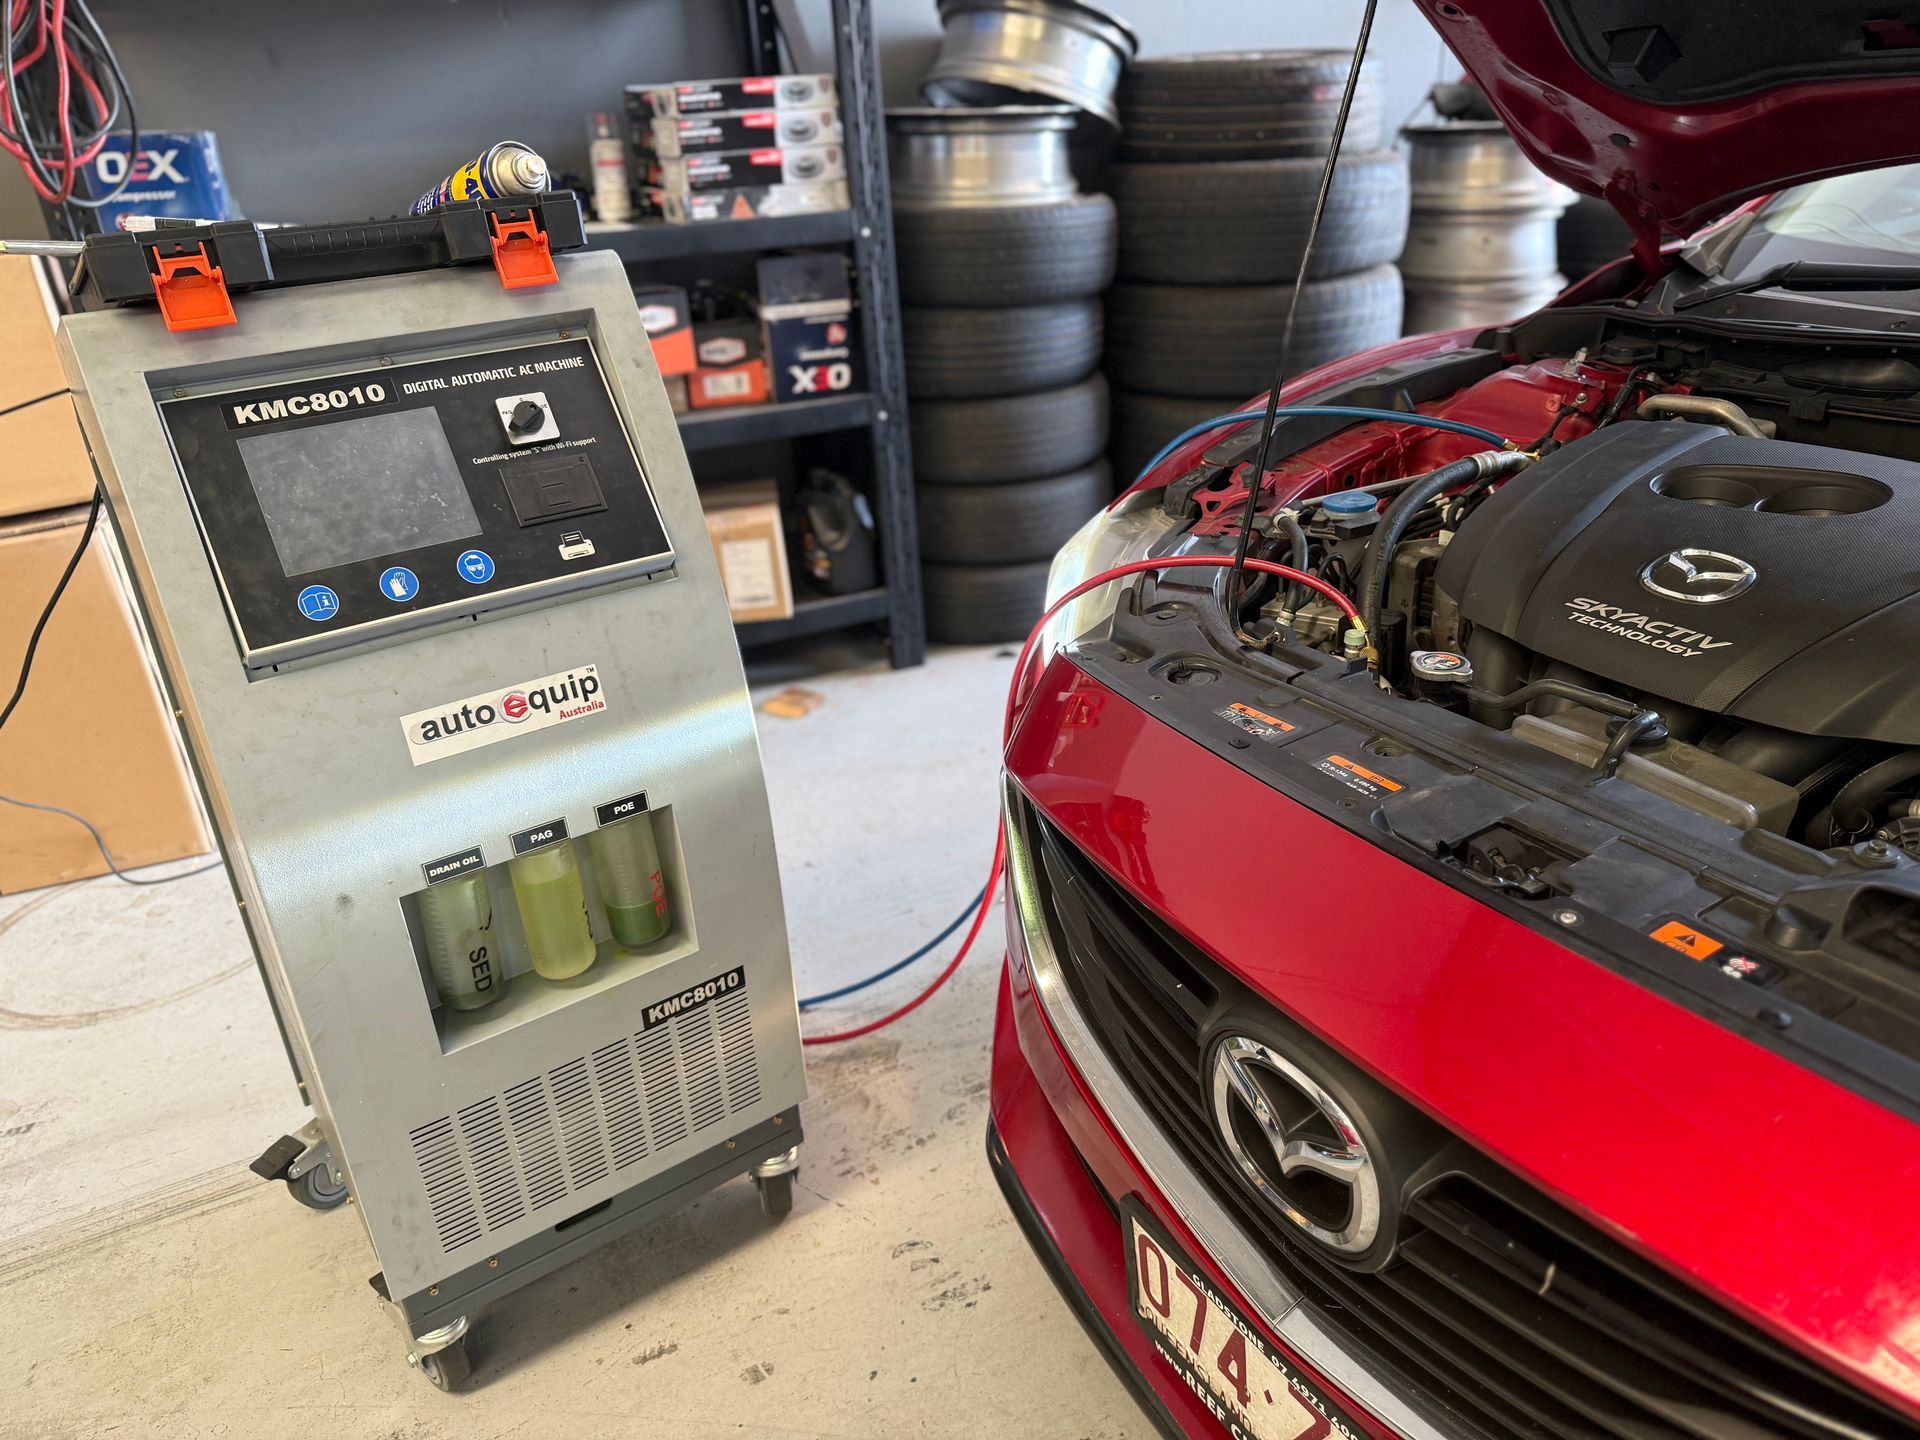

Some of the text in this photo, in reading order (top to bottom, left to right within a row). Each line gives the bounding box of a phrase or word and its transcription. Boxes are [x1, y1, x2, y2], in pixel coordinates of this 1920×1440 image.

[96, 149, 185, 184] OEX
[402, 356, 585, 395] DIGITAL AUTOMATIC AC MACHINE
[233, 384, 386, 425] KMC8010
[472, 453, 509, 465] Controlling
[509, 449, 532, 459] system
[541, 444, 556, 452] with
[556, 440, 572, 449] Wi-Fi
[572, 437, 597, 446] support
[1564, 597, 1734, 649] SKYACTIV
[1567, 611, 1703, 658] TECHNOLOGY
[559, 700, 605, 720] Australia
[613, 801, 635, 815] POE
[530, 829, 553, 844] PAG
[429, 855, 480, 877] DRAIN OIL
[648, 972, 739, 1023] KMC8010
[1192, 1274, 1265, 1353] GLADSTONE
[1271, 1355, 1287, 1374] 07
[1292, 1377, 1327, 1415] 4971
